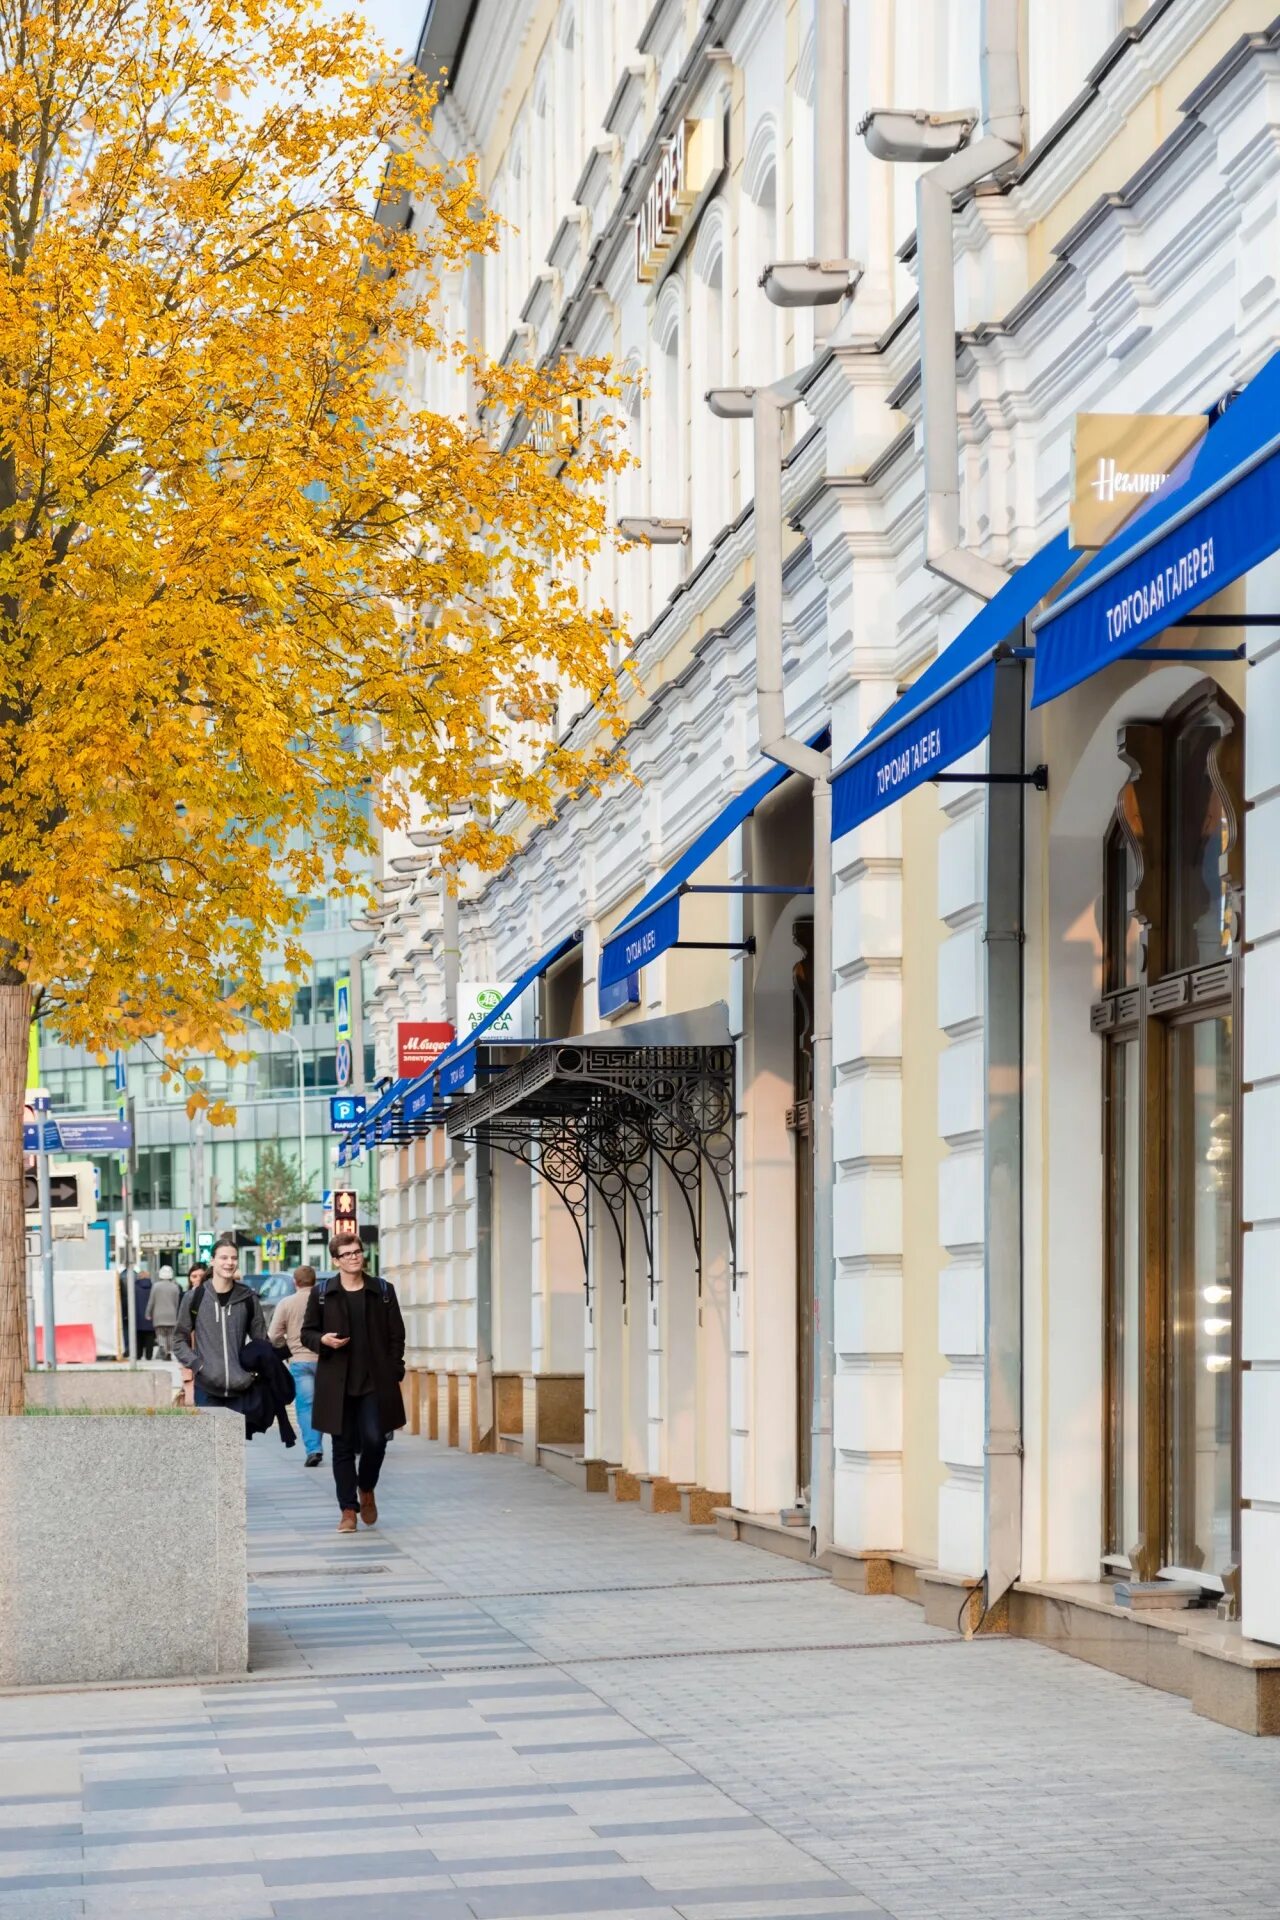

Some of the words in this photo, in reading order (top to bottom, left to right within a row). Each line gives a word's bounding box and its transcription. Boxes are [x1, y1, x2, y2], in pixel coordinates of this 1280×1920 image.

[635, 118, 685, 283] ГАЛЕРЕЯ
[1106, 573, 1164, 643] ТОРГОВАЯ
[1166, 537, 1215, 602] ГАЛЕРЕЯ
